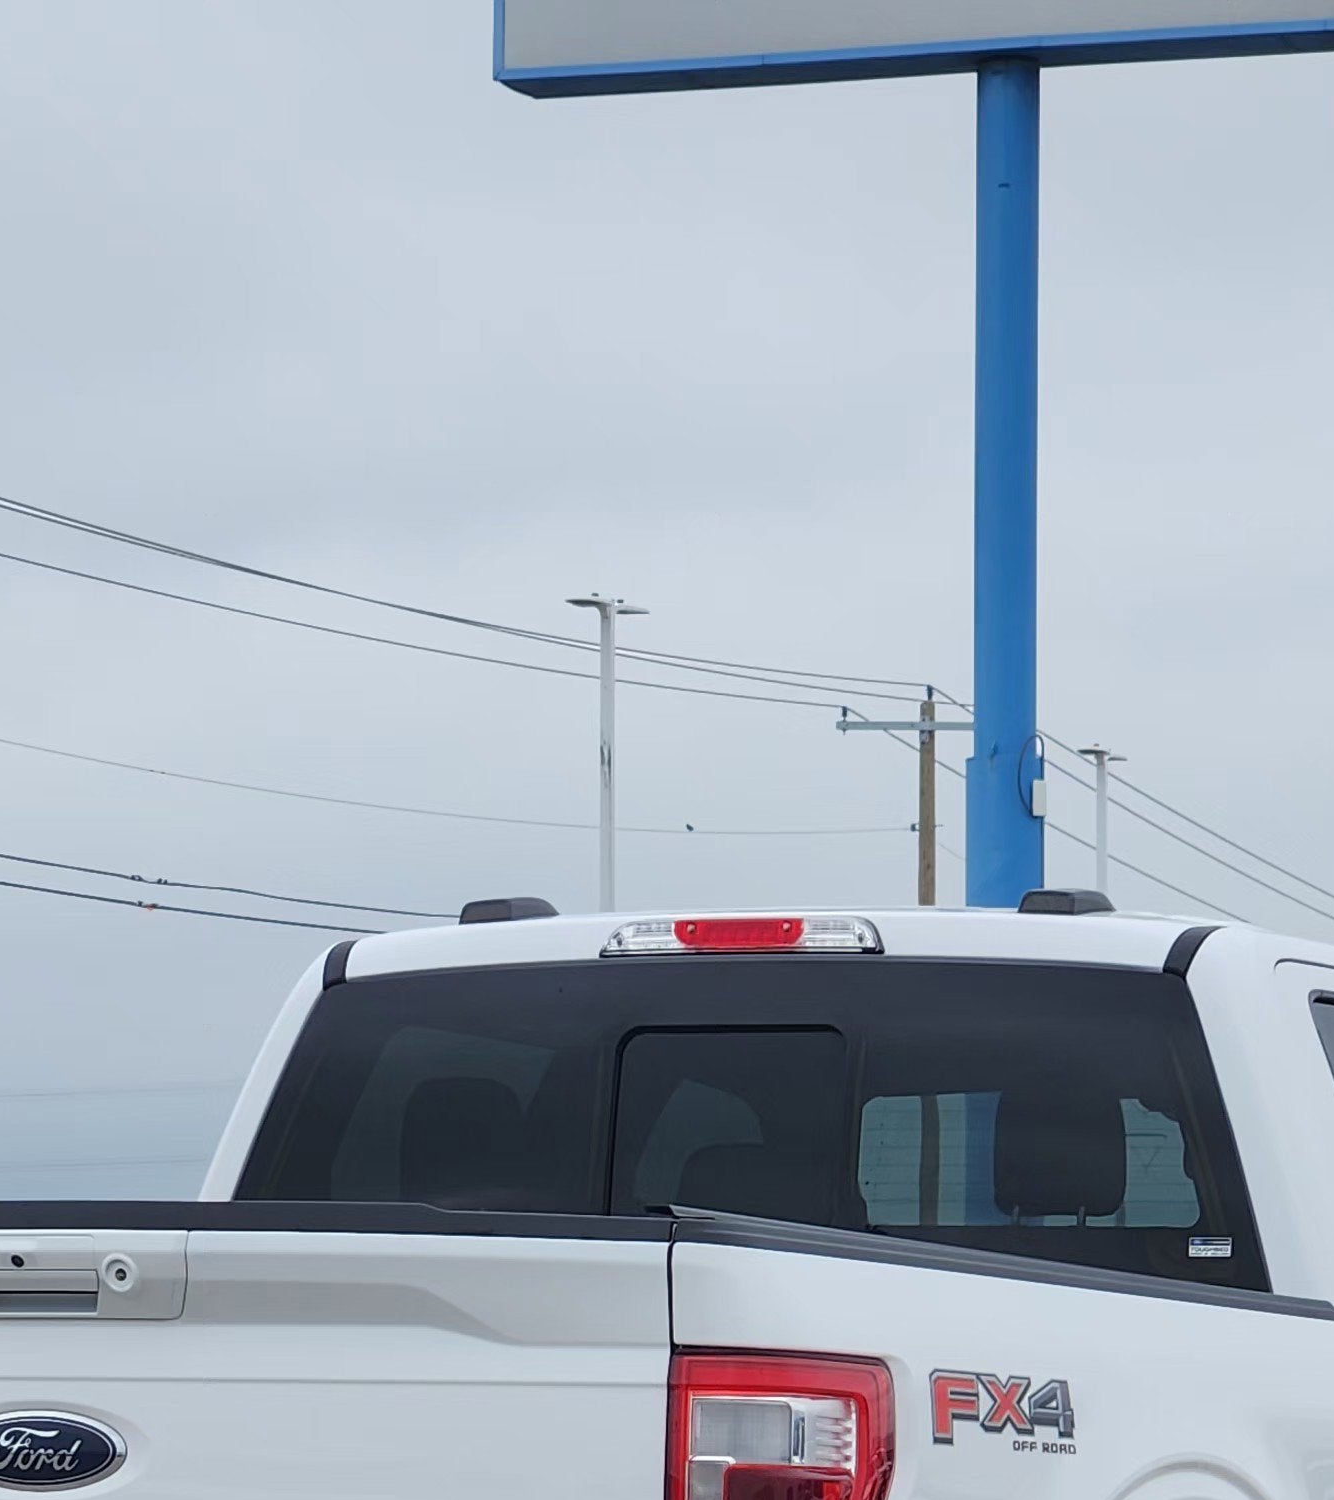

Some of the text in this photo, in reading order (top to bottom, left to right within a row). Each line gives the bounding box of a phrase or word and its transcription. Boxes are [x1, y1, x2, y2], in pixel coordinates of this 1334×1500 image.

[929, 1368, 1076, 1446] FX4
[1012, 1440, 1077, 1455] OFF ROAD
